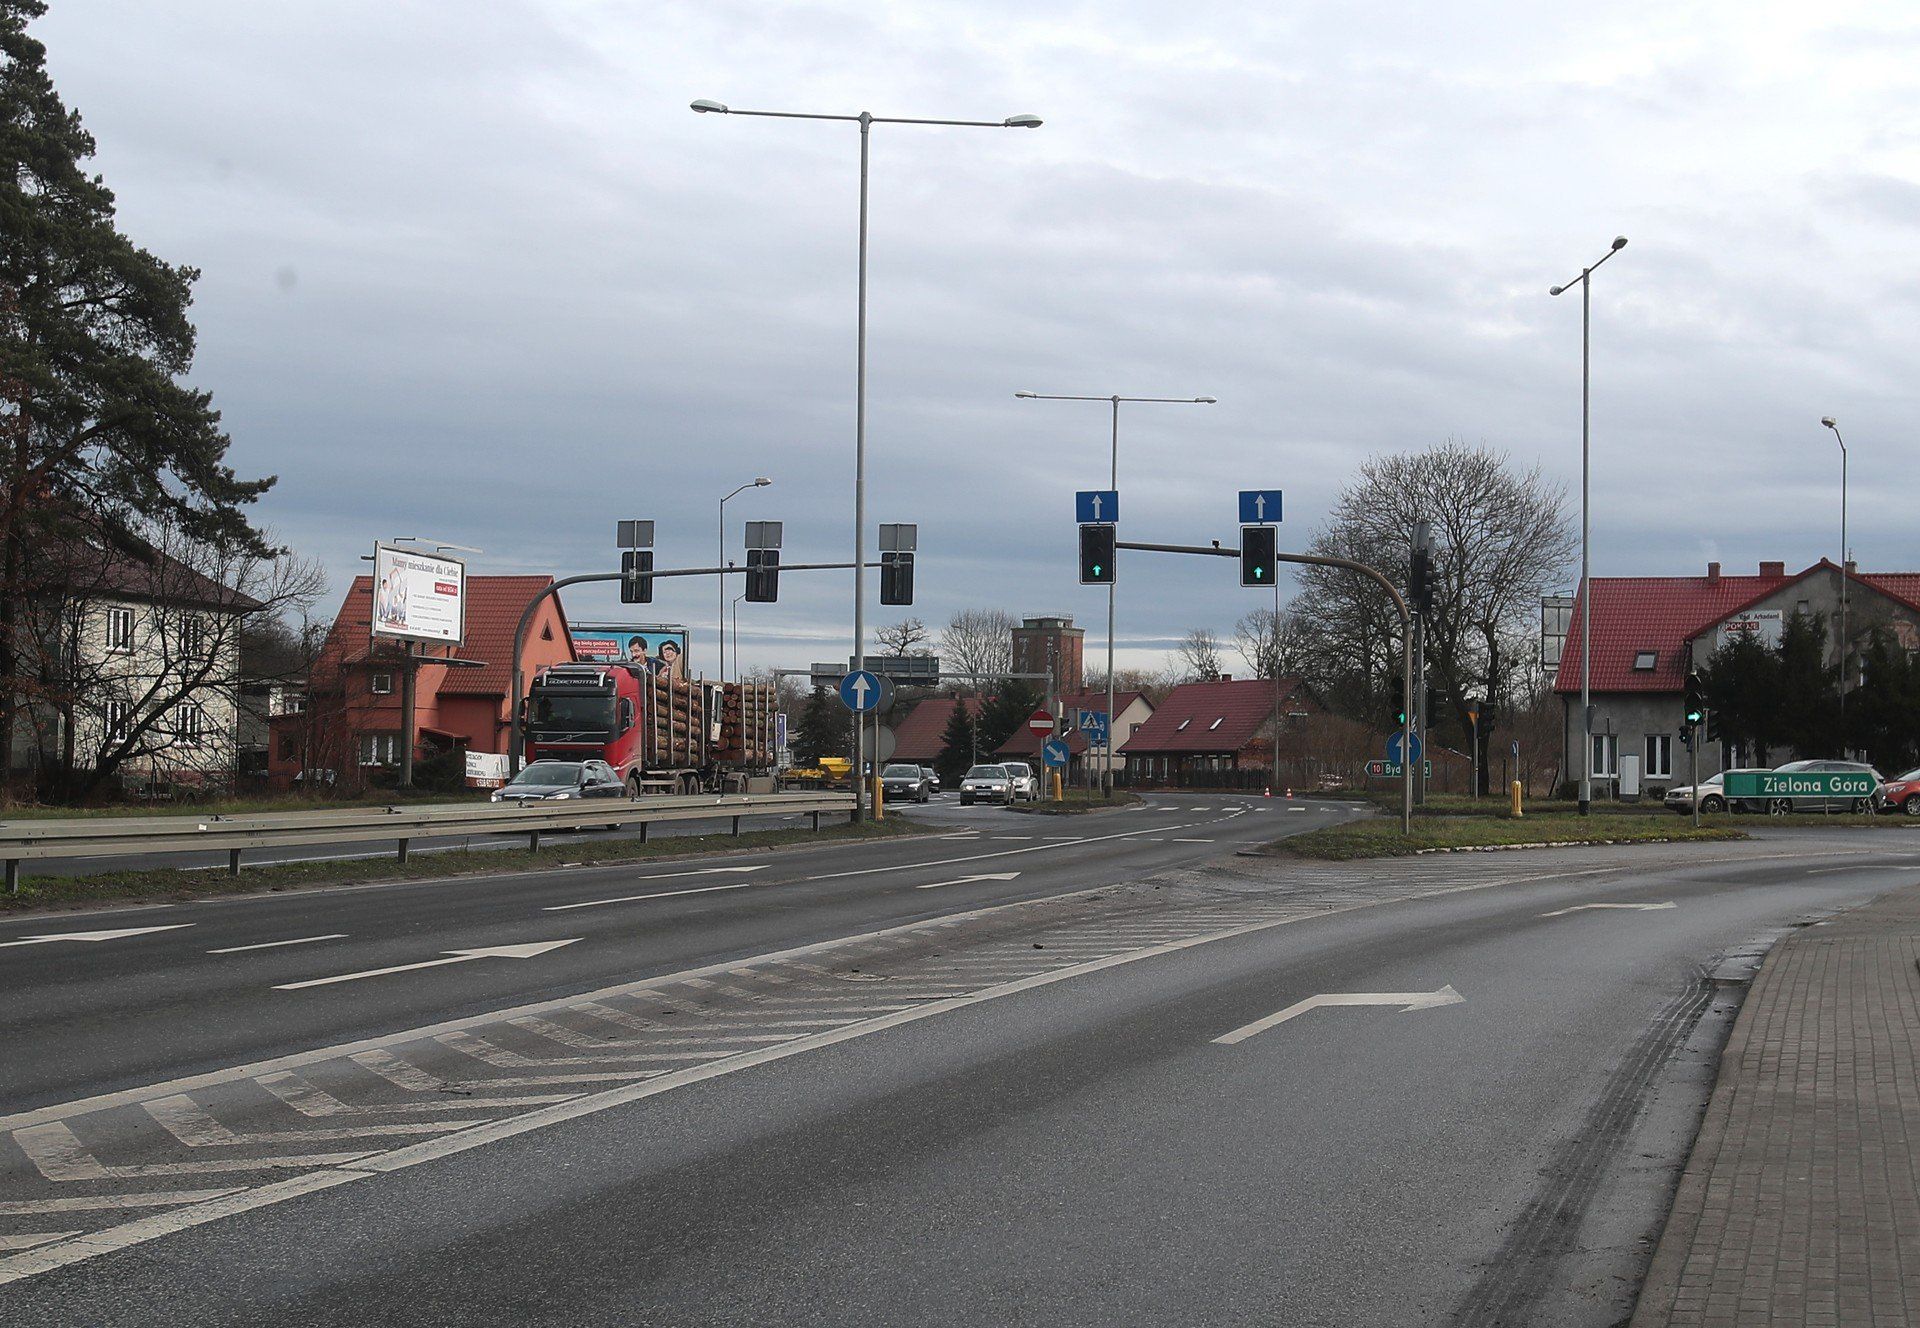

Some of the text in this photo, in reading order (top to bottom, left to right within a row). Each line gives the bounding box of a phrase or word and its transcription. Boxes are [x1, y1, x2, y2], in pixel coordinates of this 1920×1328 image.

[408, 560, 435, 573] mieszkanie
[1373, 764, 1381, 773] 10
[1763, 776, 1868, 792] Zielona Góra
